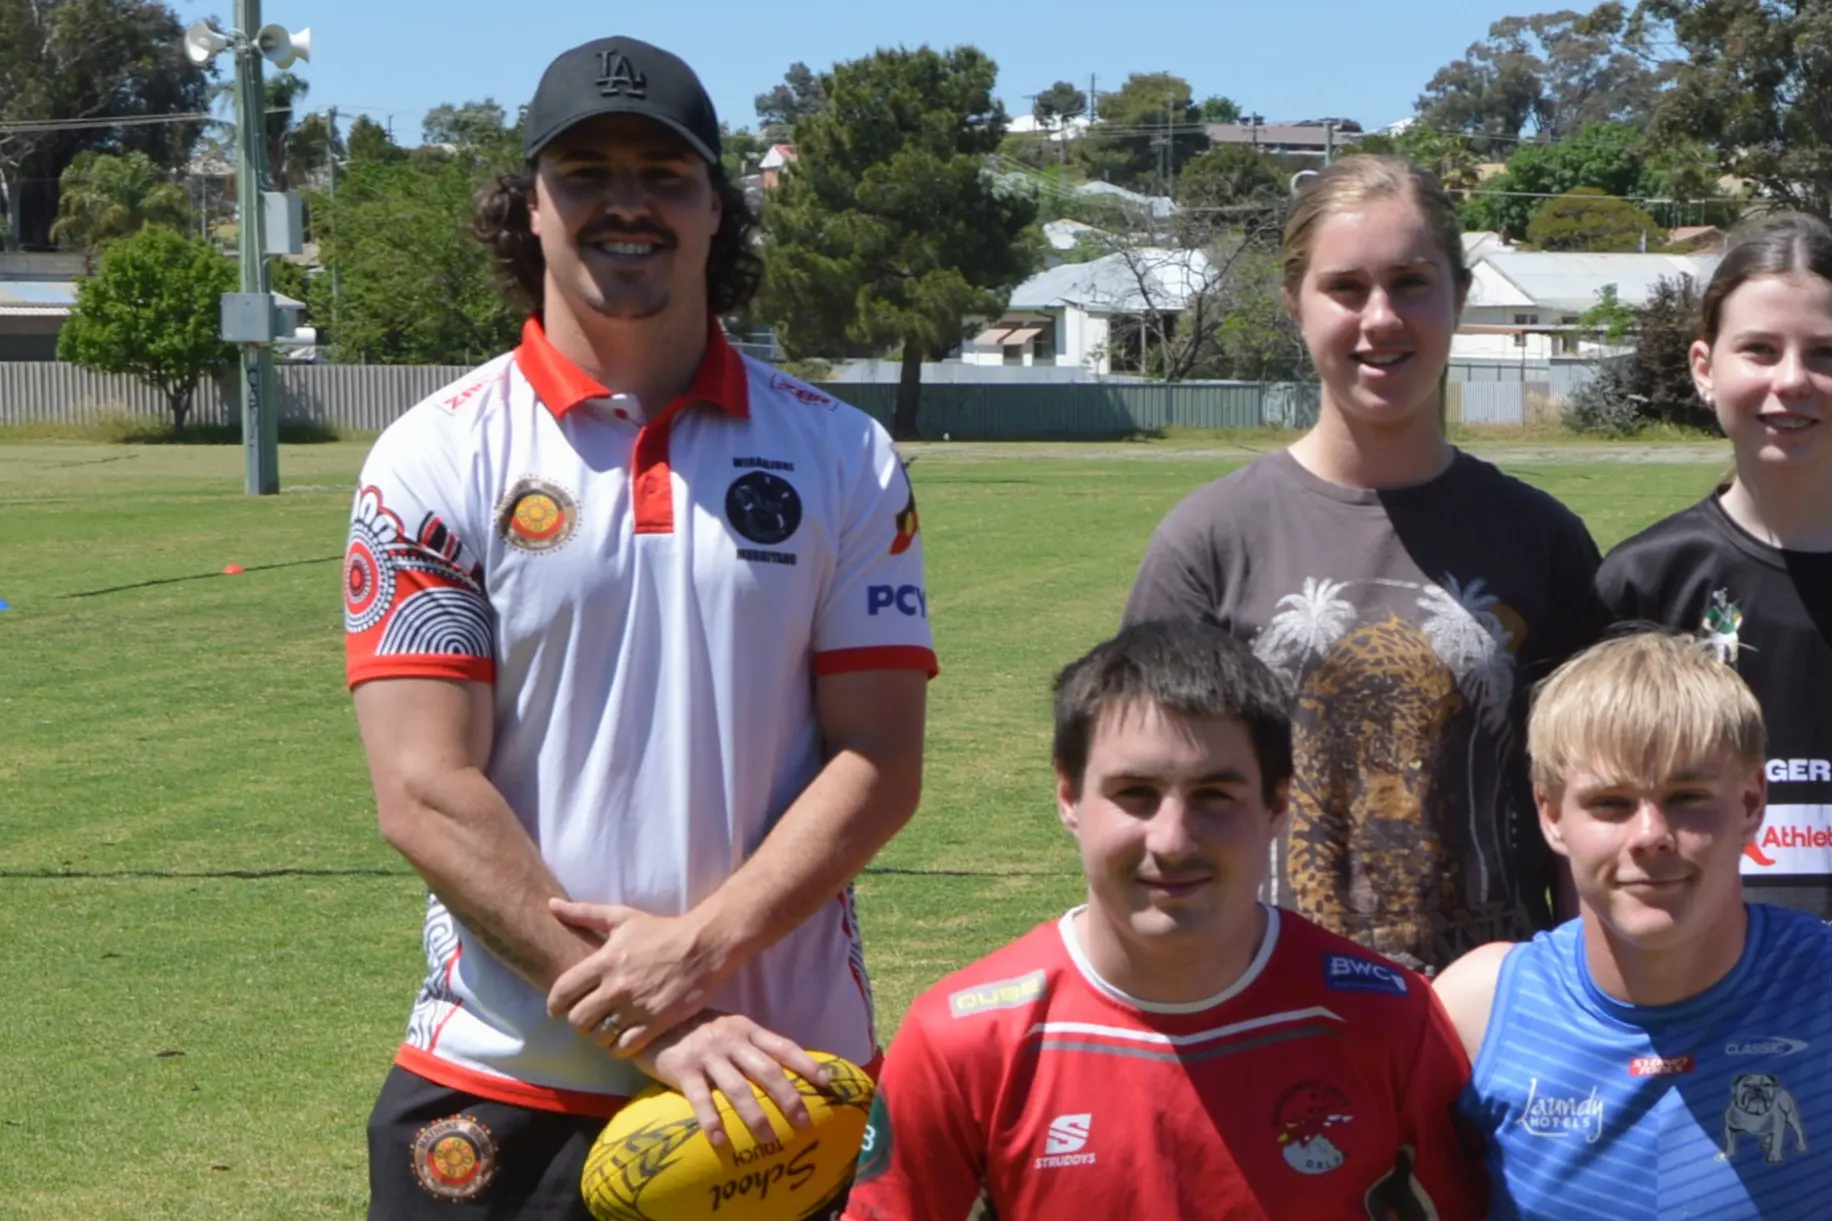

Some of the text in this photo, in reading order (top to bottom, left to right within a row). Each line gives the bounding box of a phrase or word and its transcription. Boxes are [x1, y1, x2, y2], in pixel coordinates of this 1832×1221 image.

[595, 49, 647, 100] LA
[1330, 956, 1392, 981] BWC
[1725, 1041, 1788, 1056] CLASSIC
[1516, 1077, 1604, 1144] Laundy
[1530, 1116, 1592, 1129] HOTELS
[1034, 1153, 1096, 1169] STRUDDYS
[708, 1139, 820, 1212] School
